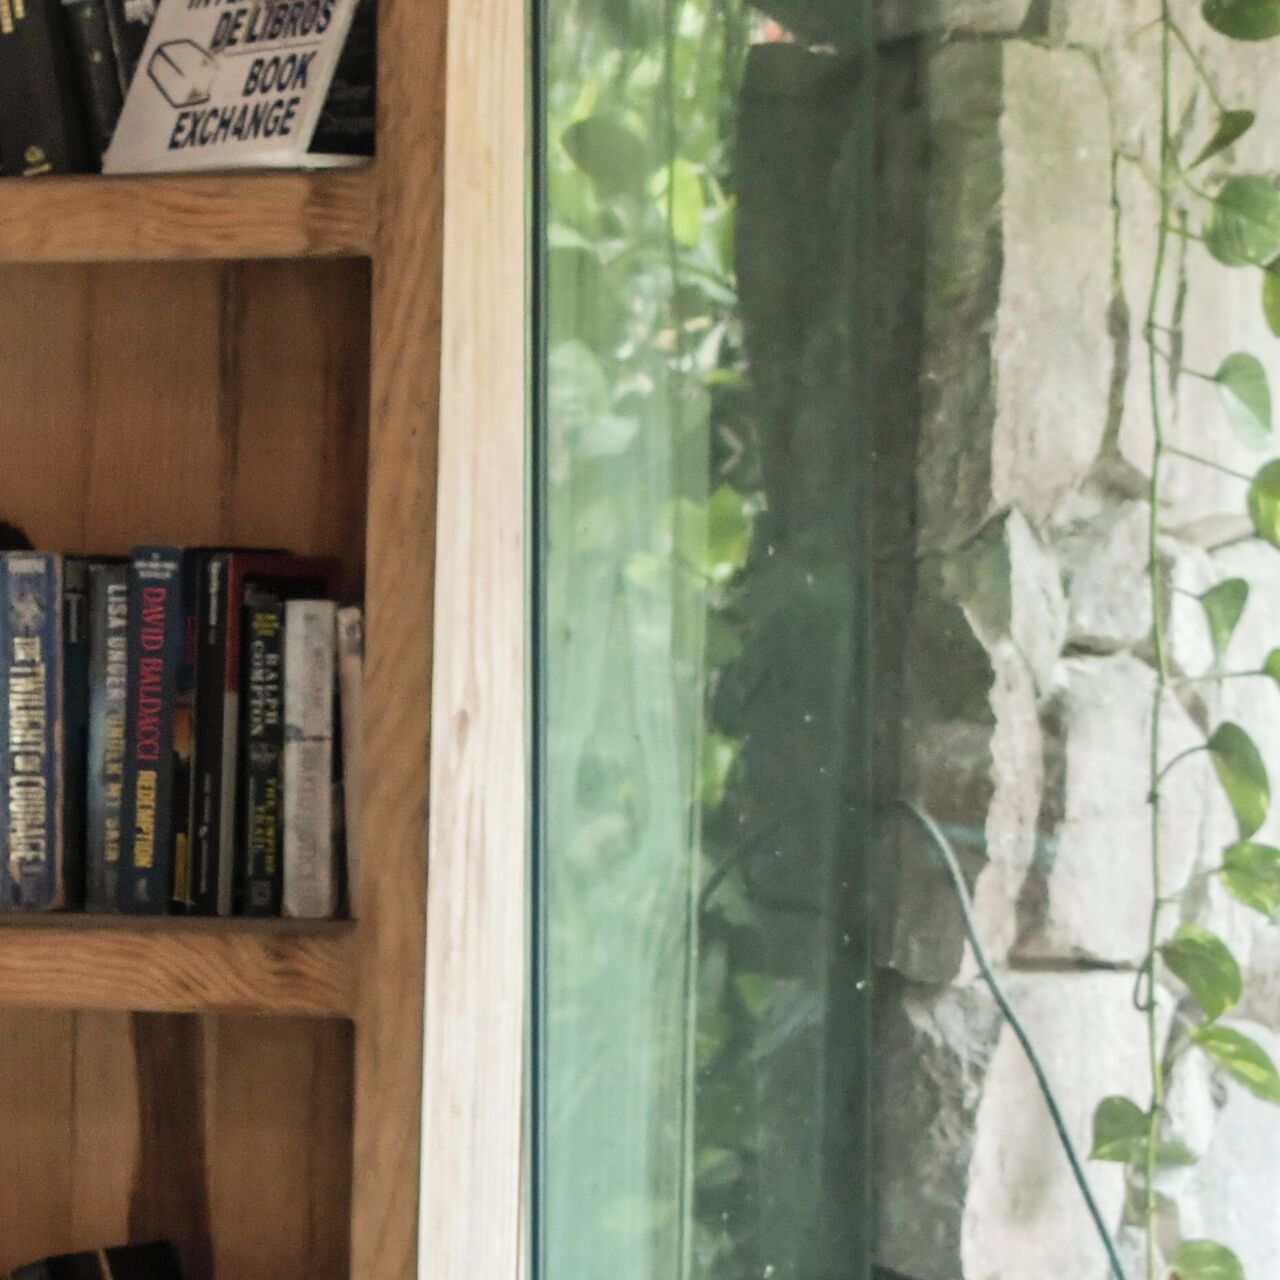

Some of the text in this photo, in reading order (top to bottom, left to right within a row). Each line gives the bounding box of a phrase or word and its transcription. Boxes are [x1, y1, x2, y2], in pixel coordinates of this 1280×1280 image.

[211, 8, 247, 48] DE
[242, 50, 317, 97] BOOK
[168, 97, 301, 150] EXCHANGE
[106, 584, 126, 701] LISA UNGER
[134, 587, 166, 762] DAVID BALDACCI
[8, 663, 47, 756] TWILIGHT
[250, 640, 265, 736] COMPTON
[265, 652, 279, 726] RALPH
[9, 775, 47, 862] COURAGE
[133, 770, 158, 868] REDEMPTION
